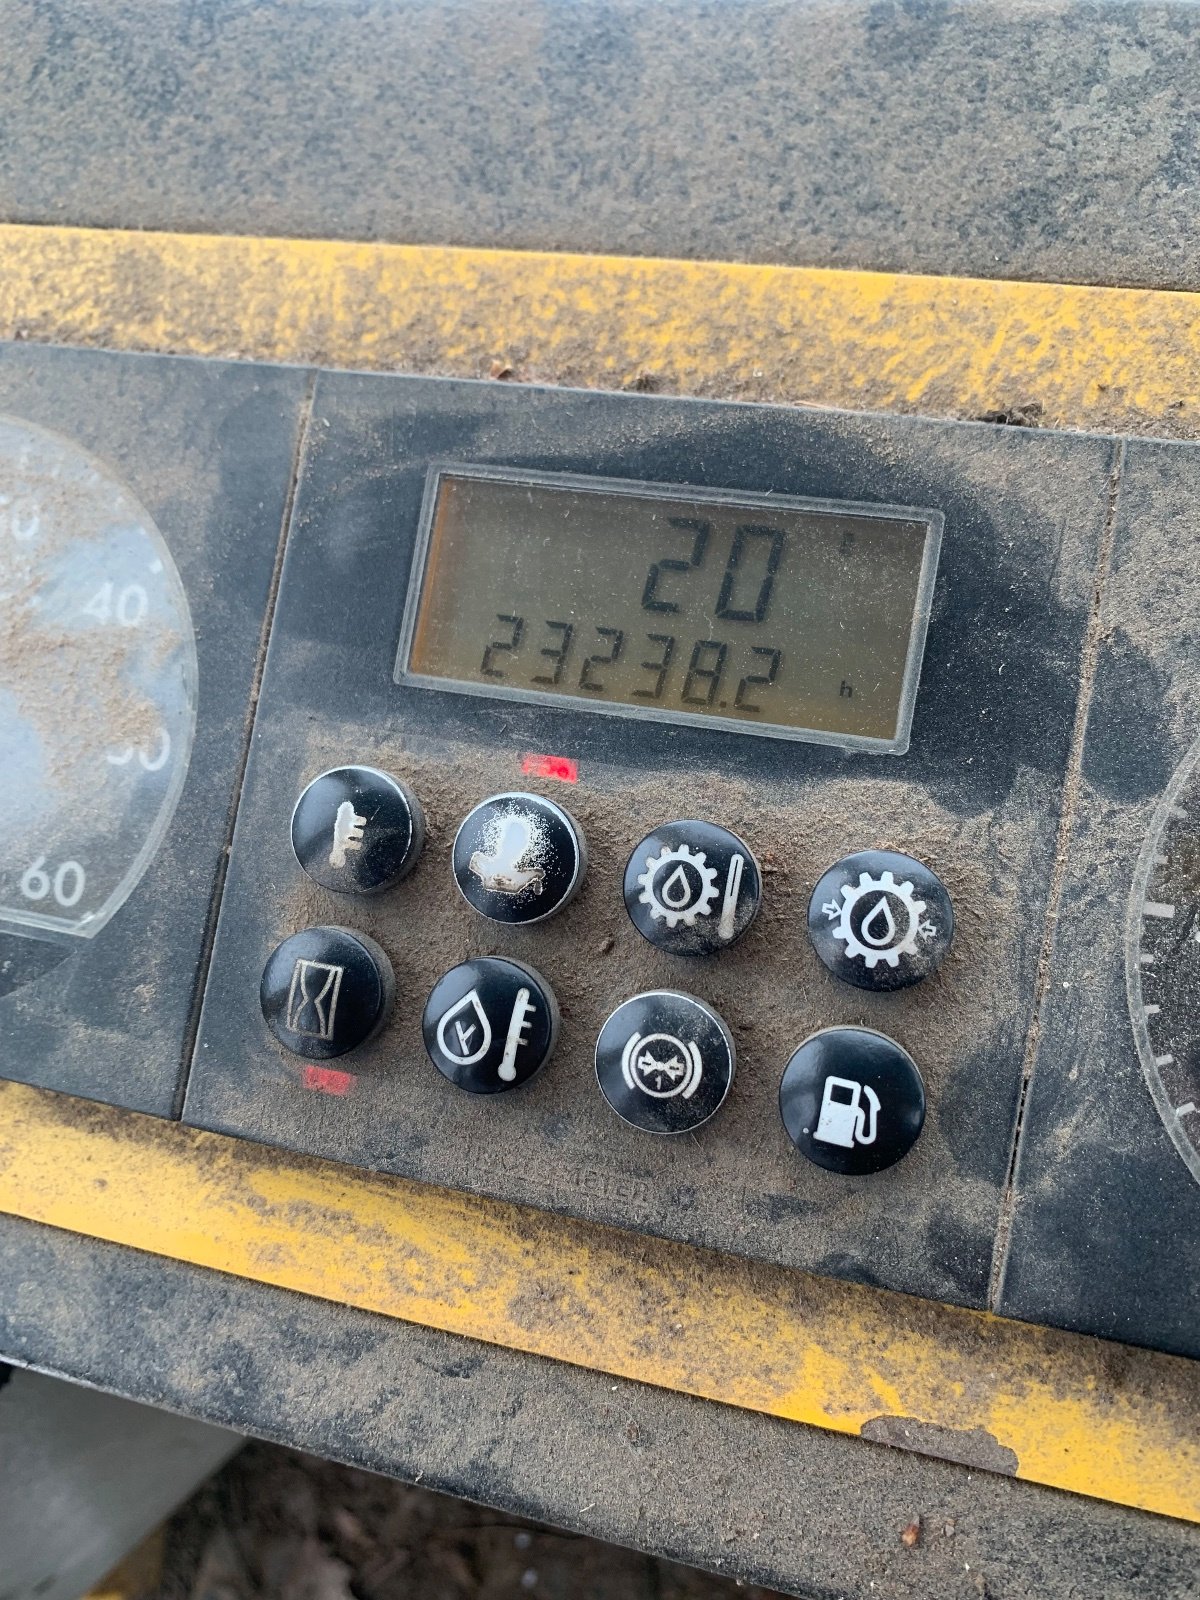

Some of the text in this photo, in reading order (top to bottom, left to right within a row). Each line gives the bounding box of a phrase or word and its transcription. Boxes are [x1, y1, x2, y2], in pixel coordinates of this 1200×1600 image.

[83, 583, 148, 627] 40
[642, 517, 786, 622] 20
[480, 614, 853, 713] 23238.2 h
[21, 856, 85, 906] 60
